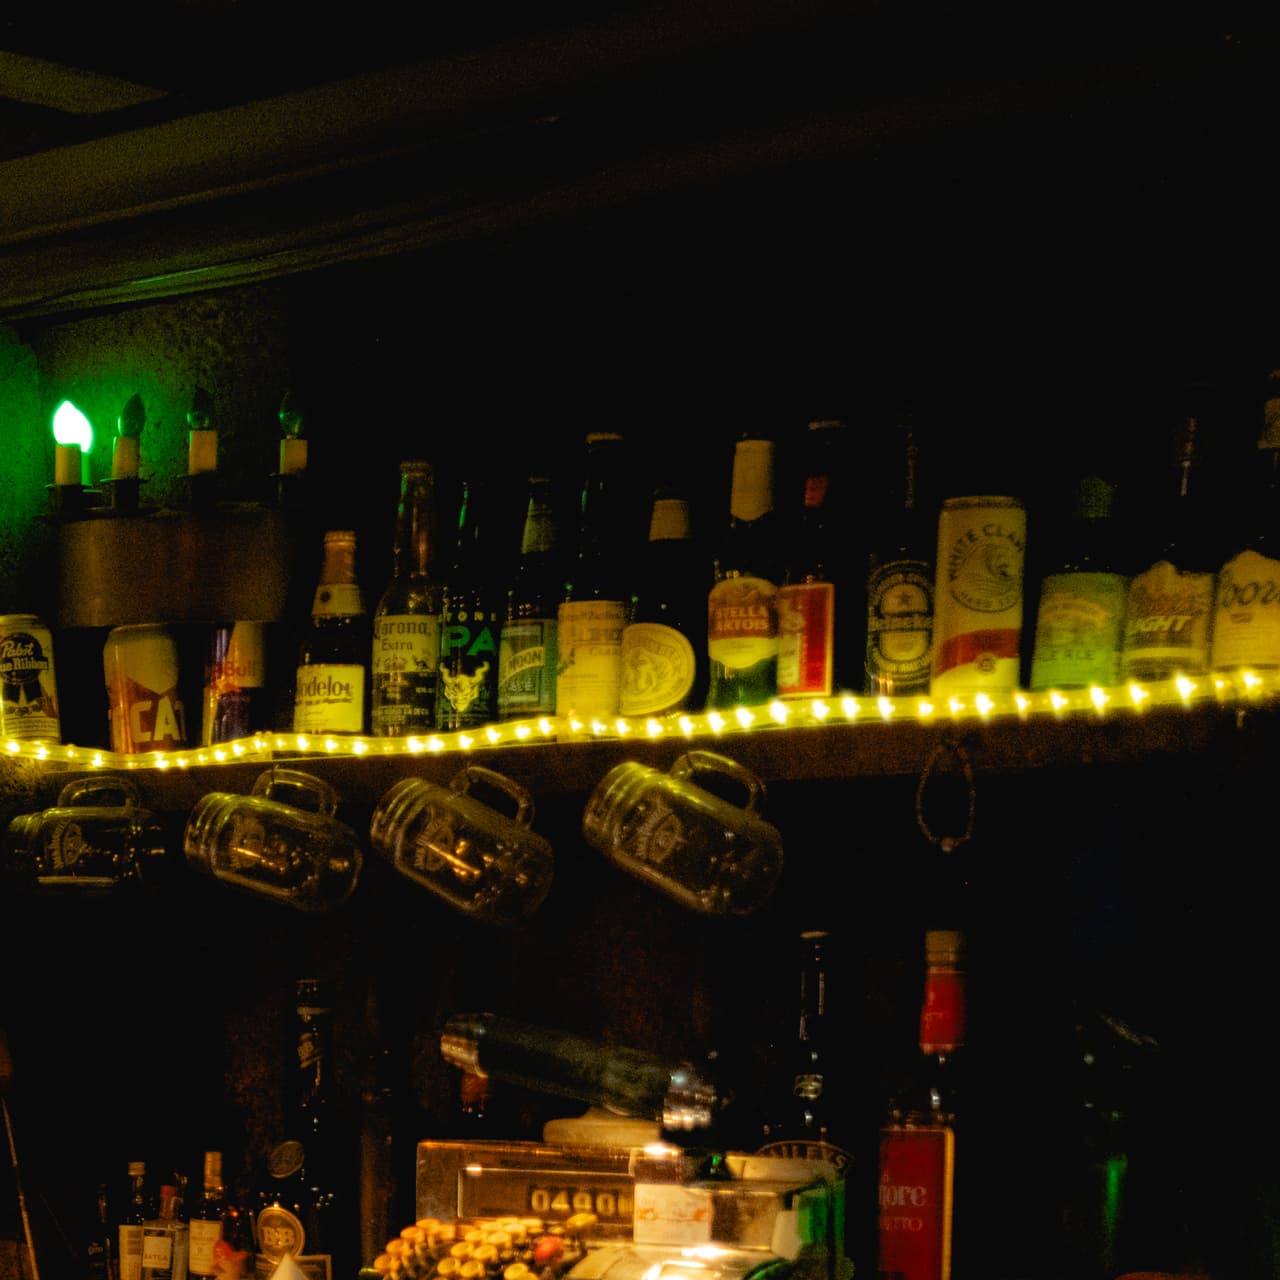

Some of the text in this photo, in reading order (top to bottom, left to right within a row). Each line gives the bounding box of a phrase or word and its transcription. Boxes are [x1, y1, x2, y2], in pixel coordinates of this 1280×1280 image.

[0, 640, 35, 659] Pabst
[441, 624, 497, 656] PA
[14, 655, 48, 672] Ribbon
